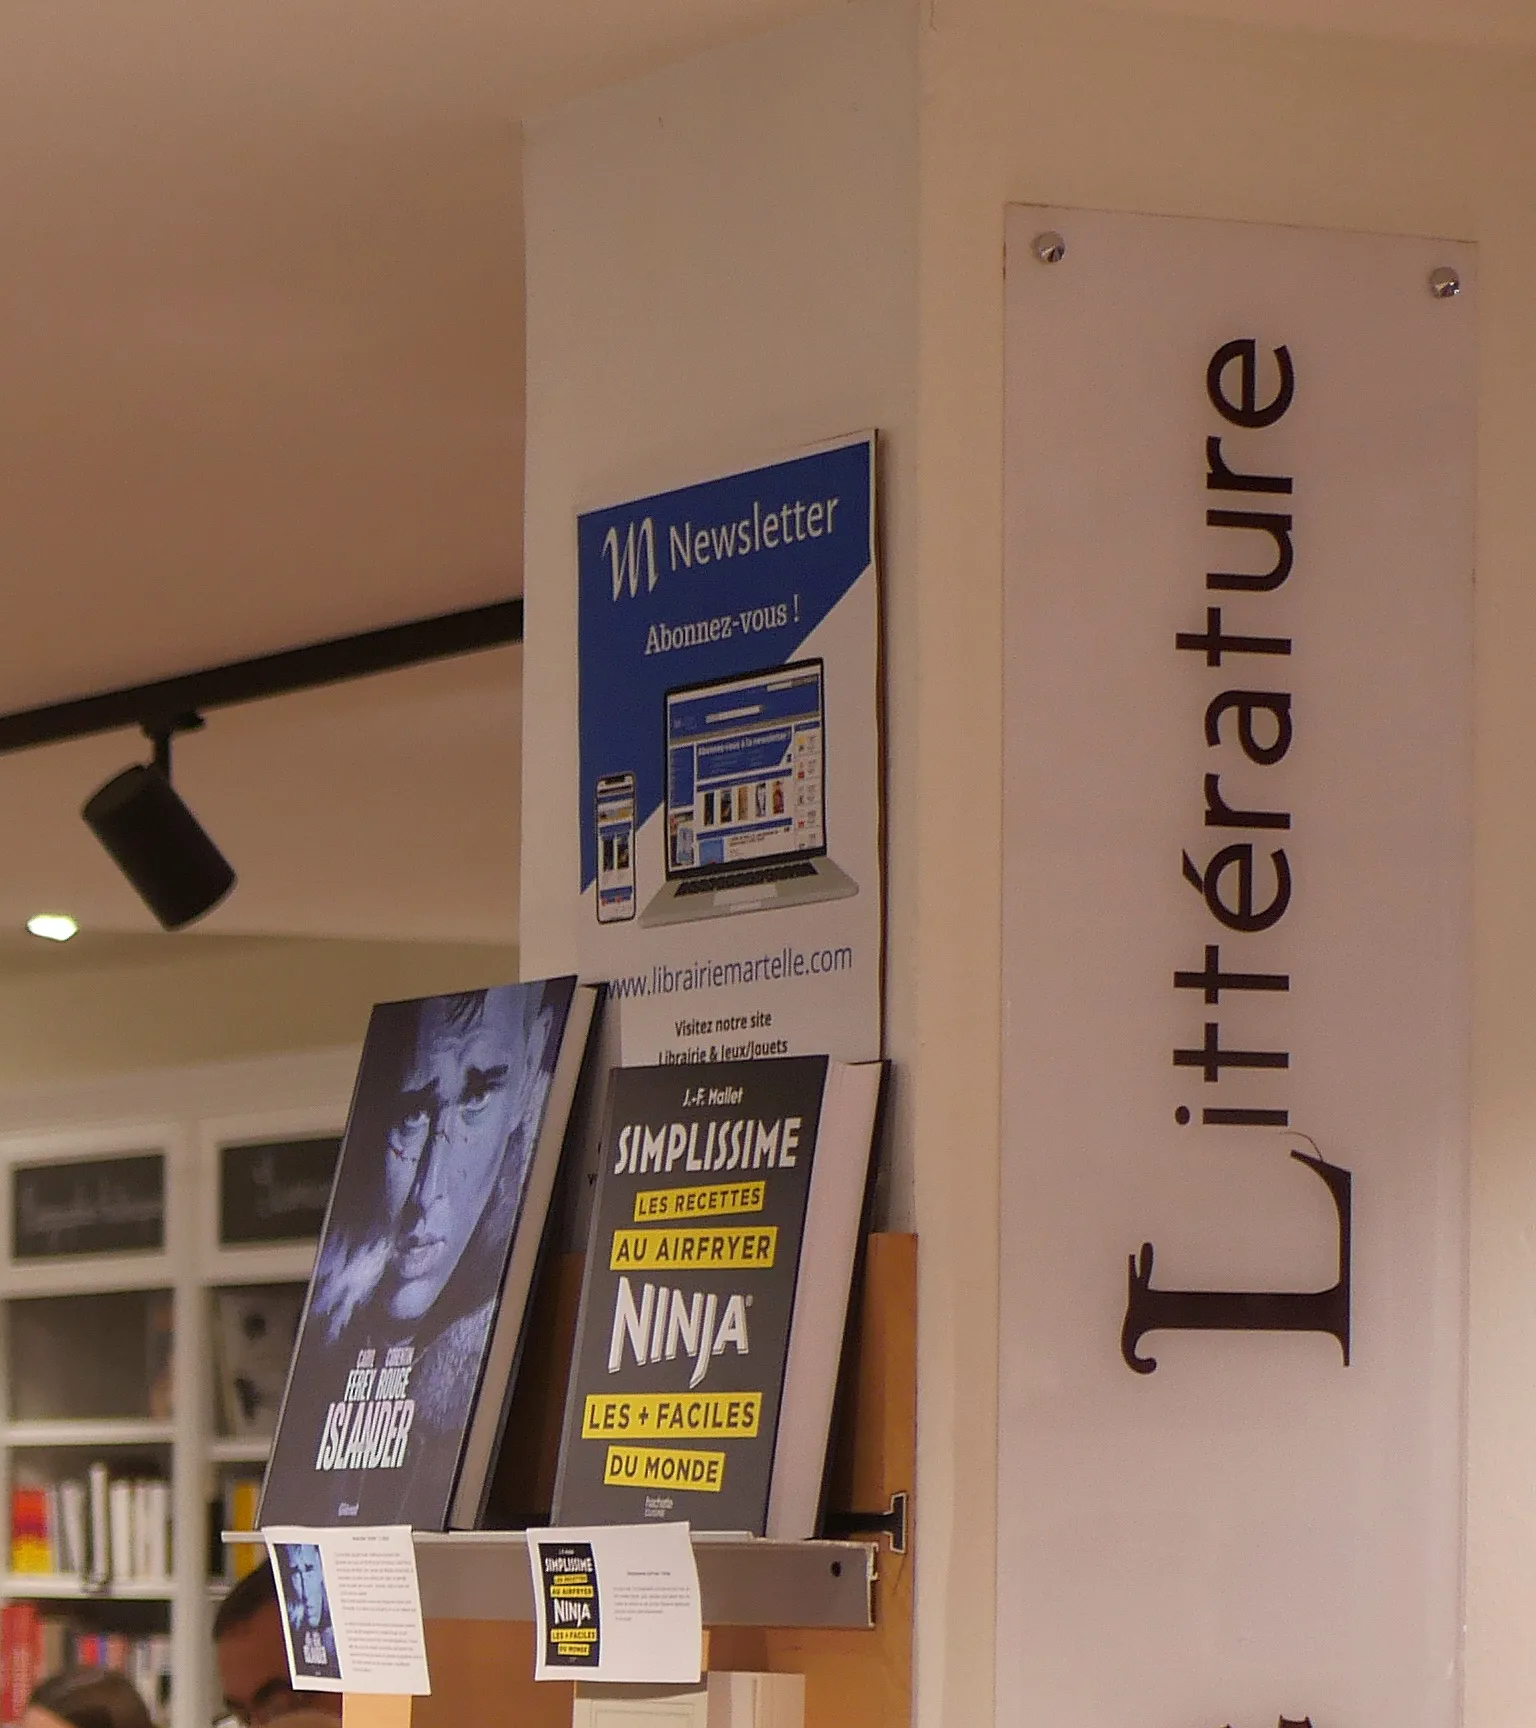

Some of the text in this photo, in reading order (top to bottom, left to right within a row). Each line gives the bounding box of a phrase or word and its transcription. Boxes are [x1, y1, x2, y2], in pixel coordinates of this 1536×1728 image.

[668, 495, 840, 572] Newsletter
[644, 594, 801, 656] Abonnez-vous !
[1121, 337, 1353, 1374] Littérature
[605, 946, 853, 1001] www.librairiemartelle.com
[674, 1010, 773, 1038] Visitez notre site
[658, 1044, 708, 1067] Librairie
[708, 1086, 744, 1106] Mallet
[613, 1116, 803, 1176] SIMPLISSIME
[638, 1187, 761, 1216] LES RECETTES
[616, 1234, 772, 1263] AU AIRFRYER
[607, 1275, 750, 1390] NINJA
[588, 1401, 756, 1430] LES + FACILES
[315, 1399, 416, 1471] ISLANDER
[609, 1454, 719, 1484] DU MONDE
[553, 1598, 592, 1628] NINJA
